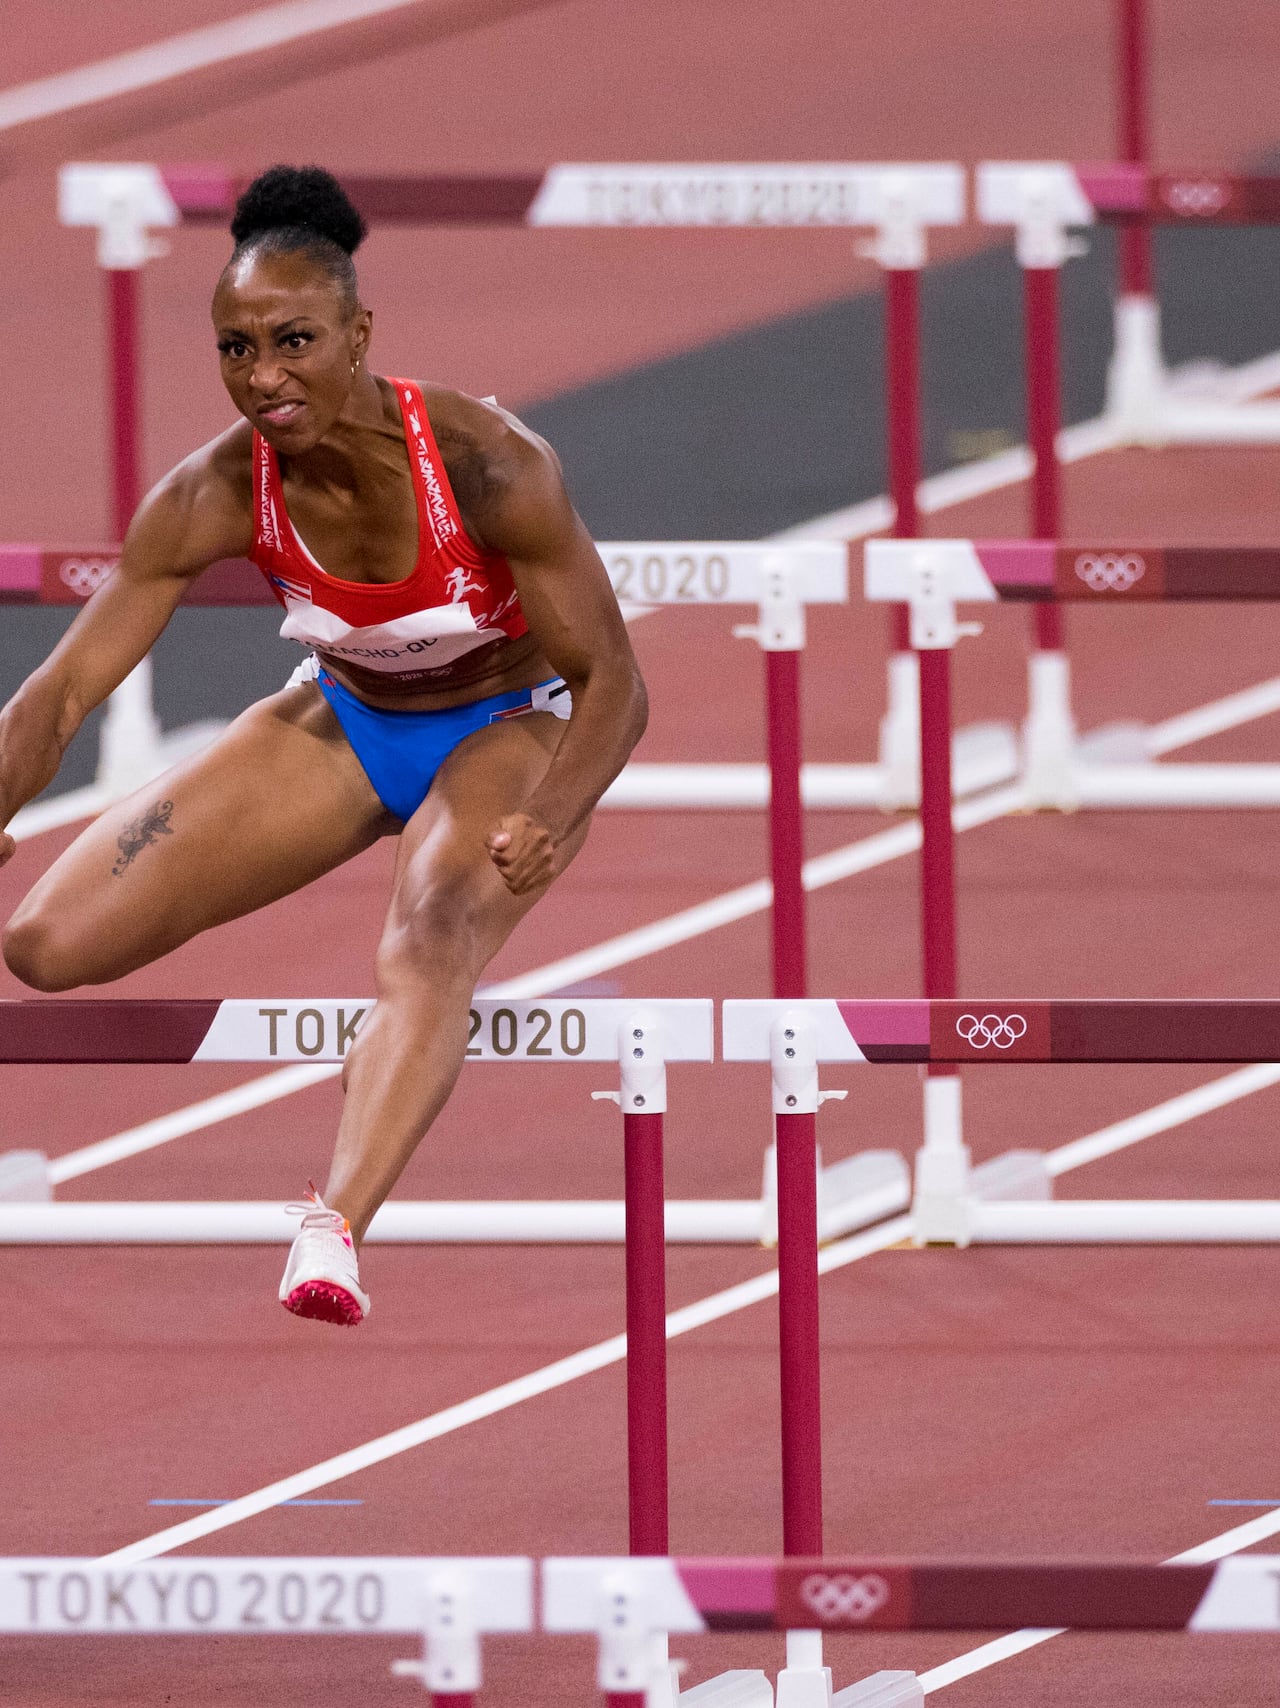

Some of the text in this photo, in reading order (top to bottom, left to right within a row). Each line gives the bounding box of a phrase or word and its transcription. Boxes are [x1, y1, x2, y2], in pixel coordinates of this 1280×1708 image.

[612, 555, 729, 600] 2020
[259, 1008, 587, 1056] TOK 2020
[19, 1571, 385, 1626] TOKYO 2020
